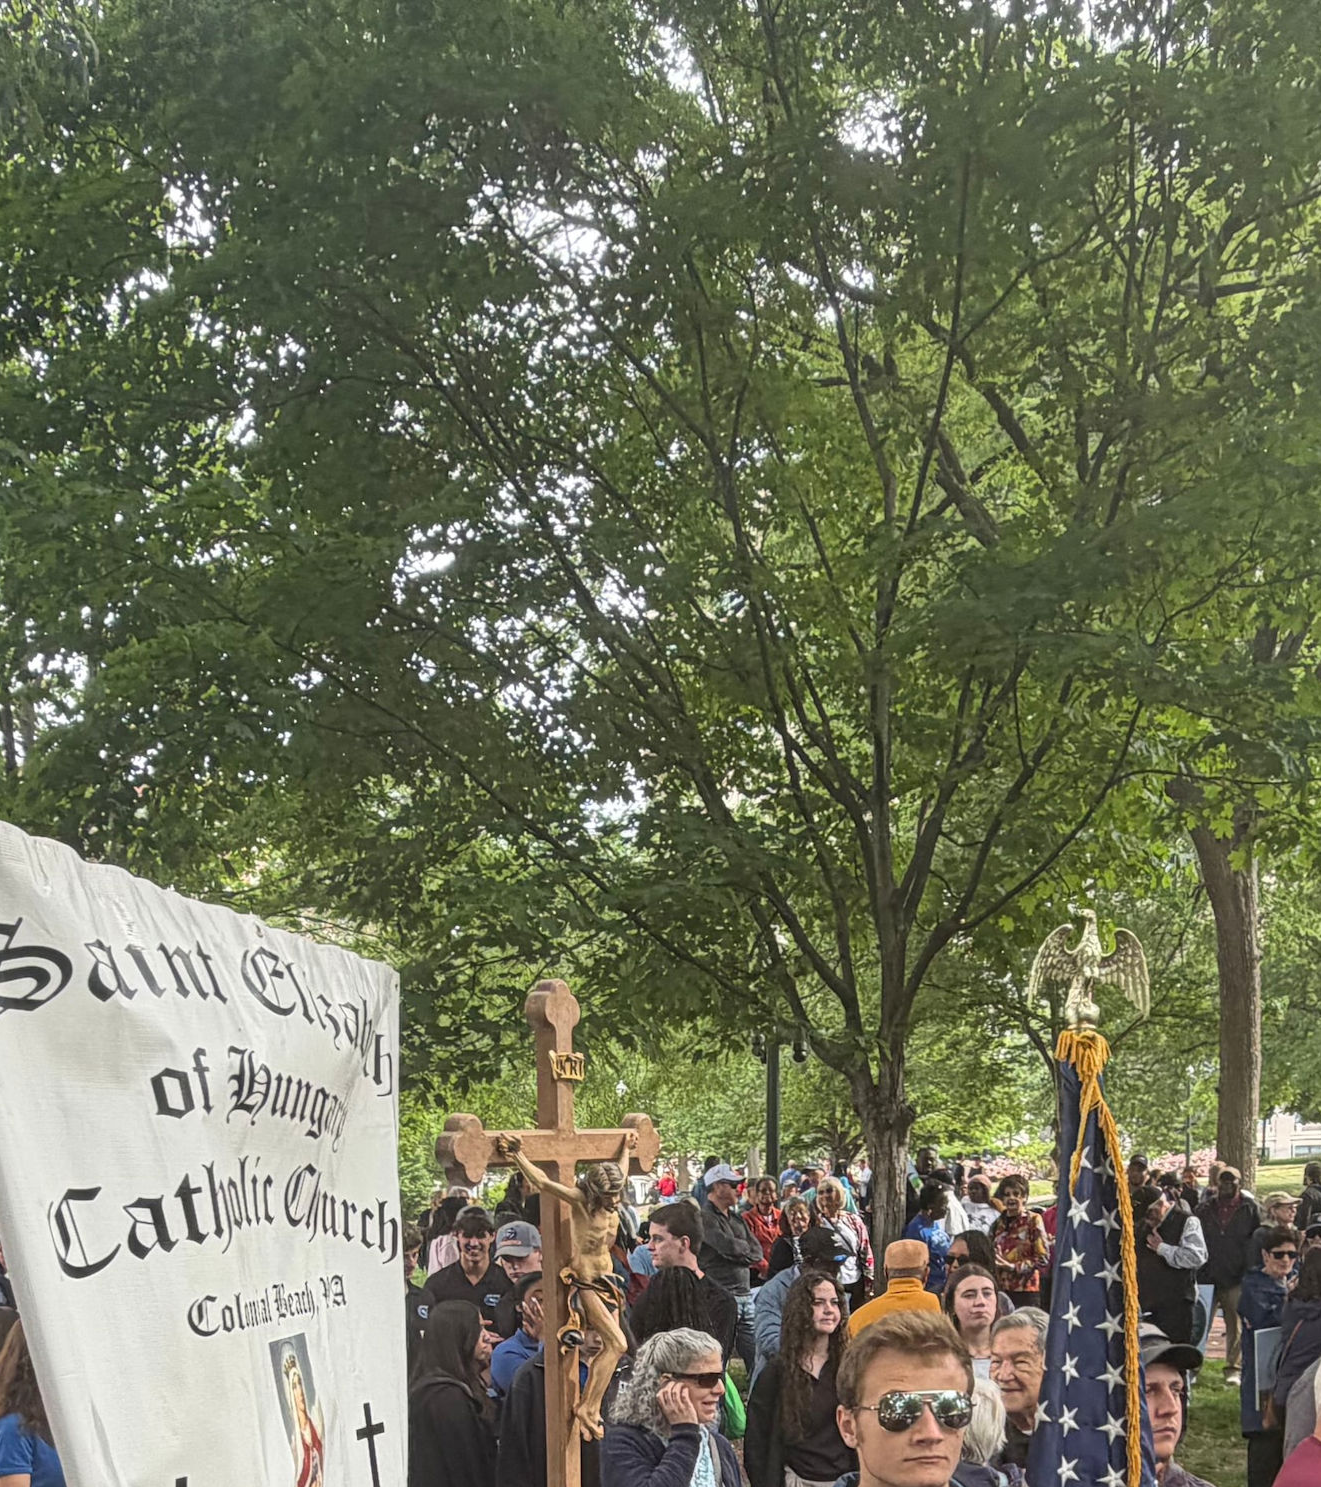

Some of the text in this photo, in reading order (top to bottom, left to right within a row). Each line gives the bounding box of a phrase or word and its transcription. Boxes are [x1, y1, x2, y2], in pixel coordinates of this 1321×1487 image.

[241, 945, 393, 1097] Elizabh
[150, 1047, 214, 1119] of
[48, 1156, 399, 1279] Catholic Church
[187, 1287, 272, 1337] Colonial
[319, 1274, 347, 1309] VA
